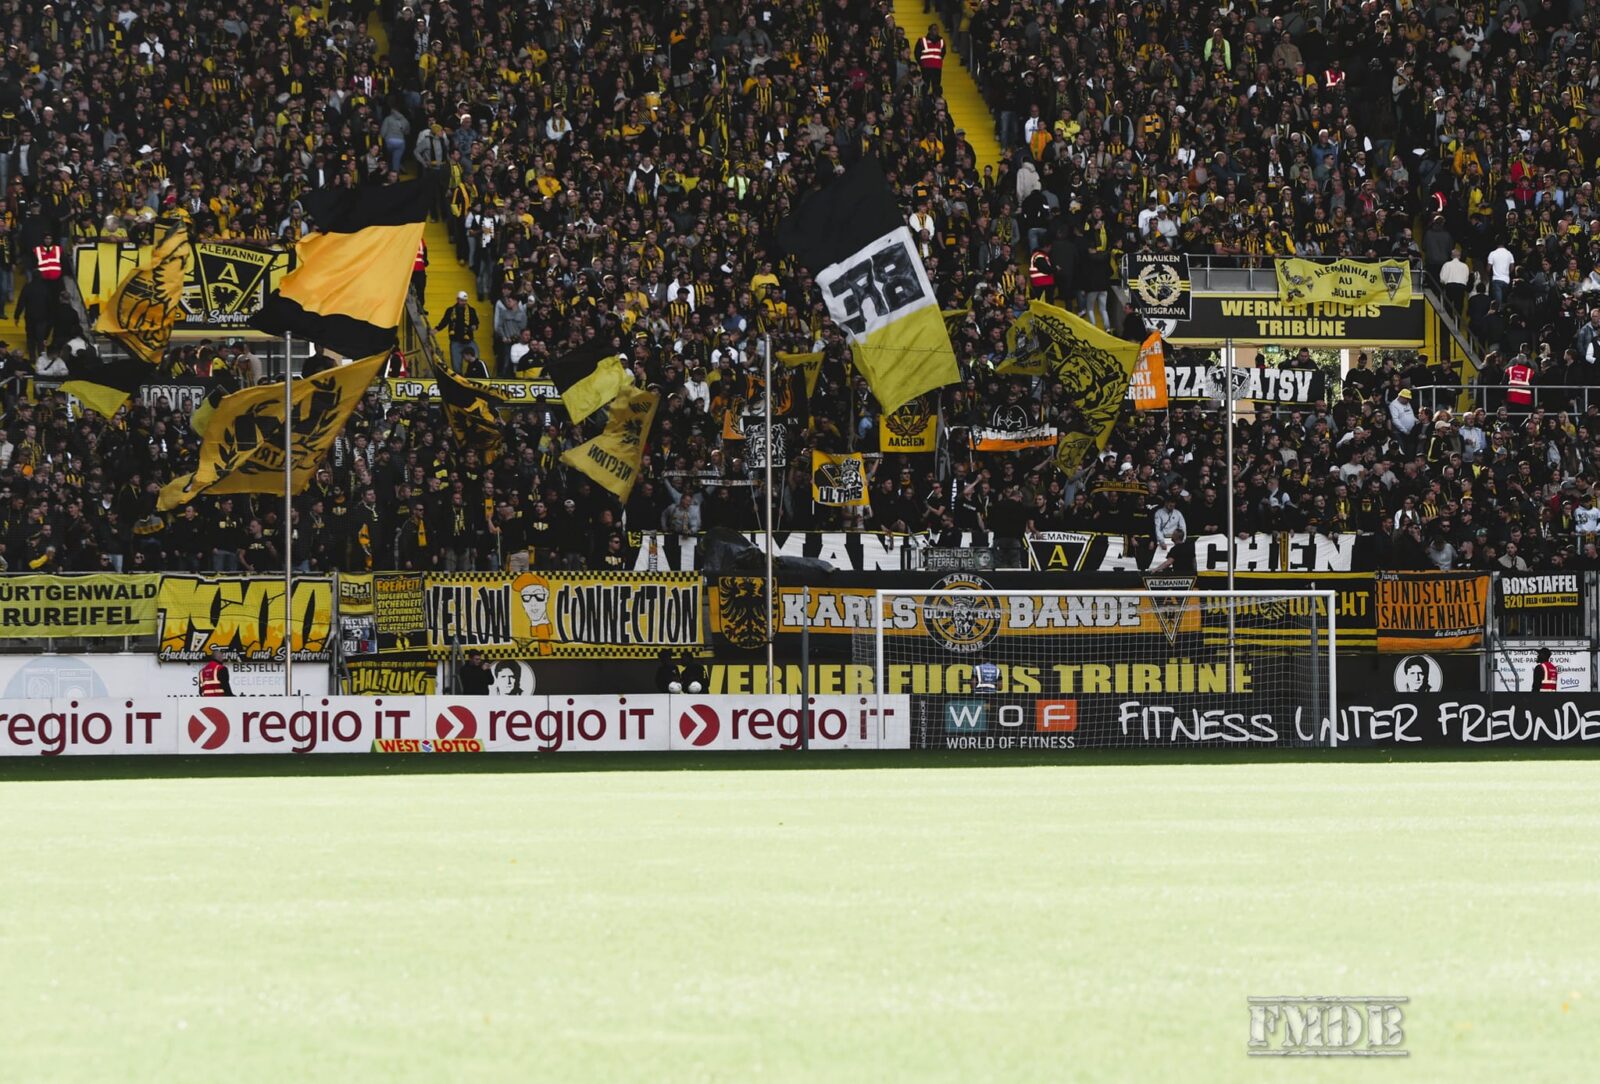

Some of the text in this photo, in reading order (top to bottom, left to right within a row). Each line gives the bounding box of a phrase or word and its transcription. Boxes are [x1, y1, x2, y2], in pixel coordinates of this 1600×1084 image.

[199, 243, 265, 263] ALEMANNIA
[1136, 254, 1180, 263] RABAUKEN
[218, 262, 239, 284] A
[1338, 276, 1352, 285] AU
[185, 311, 204, 323] und
[1134, 306, 1186, 315] AUISGRANA
[1220, 300, 1382, 318] WERNER FUCHS
[1256, 318, 1346, 336] TRIBÜNE
[396, 382, 424, 397] FÜR
[1248, 368, 1313, 402] ATSV
[888, 437, 926, 447] AACHEN
[1048, 544, 1068, 567] A
[944, 574, 983, 585] KARLS
[1149, 579, 1191, 588] ALEMANNIA
[1502, 575, 1579, 595] BOXSTAFFEL
[1504, 595, 1523, 609] 520
[3, 607, 140, 626] RUREIFEL
[427, 585, 699, 645] YELLOW CONNECTION
[782, 594, 1141, 629] KARLS BANDE
[252, 648, 270, 660] und
[274, 646, 332, 662] Sortverein
[945, 640, 985, 652] BANDE
[232, 663, 284, 673] BESTELLT.
[1053, 658, 1253, 694] TRIBÜNE
[352, 668, 426, 695] HALTUNG
[1561, 677, 1580, 686] beko
[242, 699, 363, 754] regio
[489, 698, 607, 752] regio
[1119, 701, 1278, 742] FITNESS
[1438, 701, 1600, 742] FREUNDE
[379, 739, 481, 752] WEST LOTTO
[946, 736, 1075, 749] WORLD OF FITNESS
